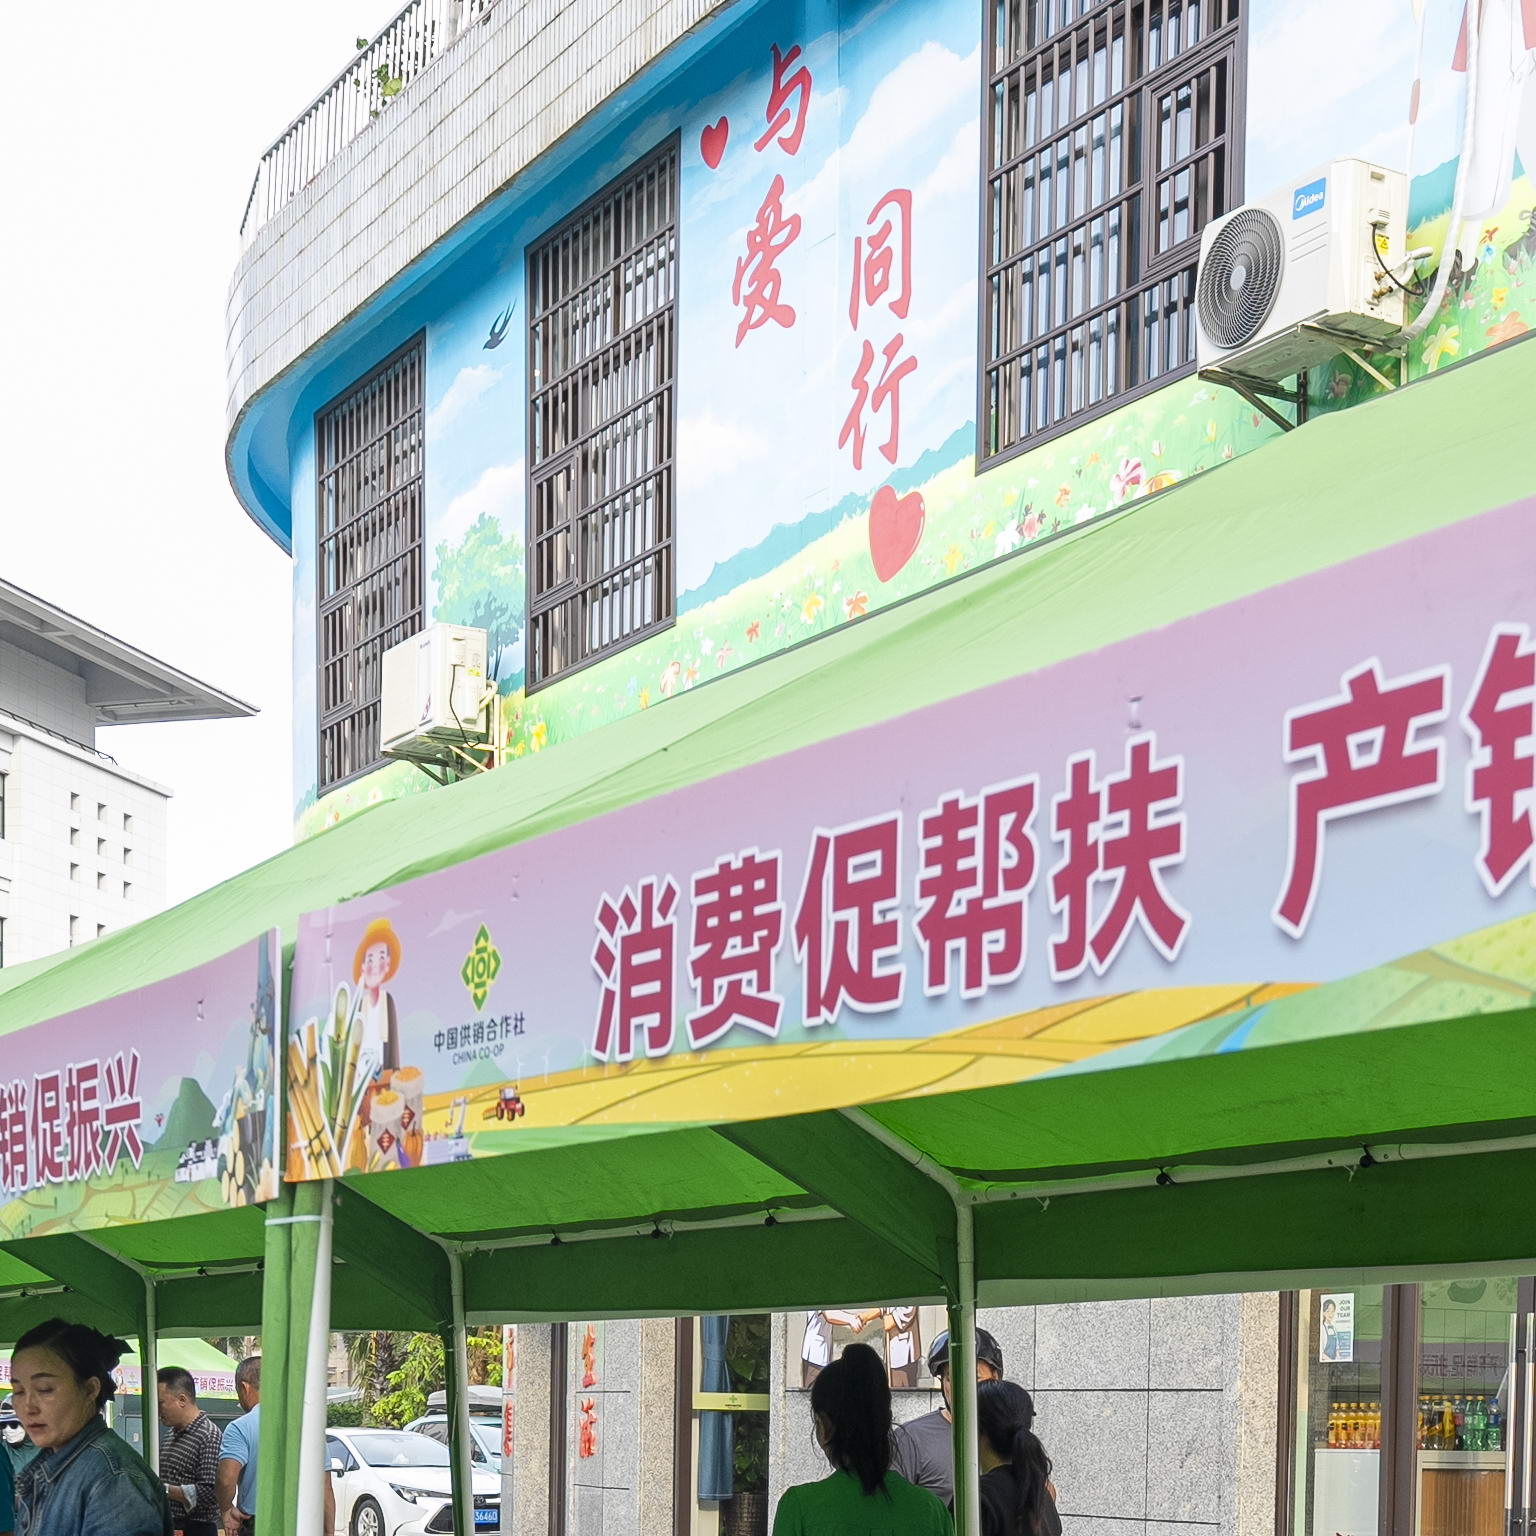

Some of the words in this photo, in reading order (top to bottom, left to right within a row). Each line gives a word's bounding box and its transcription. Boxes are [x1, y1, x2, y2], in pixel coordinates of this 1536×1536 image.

[1295, 191, 1324, 212] Midea
[838, 188, 917, 470] 同行
[590, 733, 1191, 1064] 消费促帮扶
[434, 1011, 525, 1053] 中国供销合作社
[453, 1049, 478, 1066] CHINA
